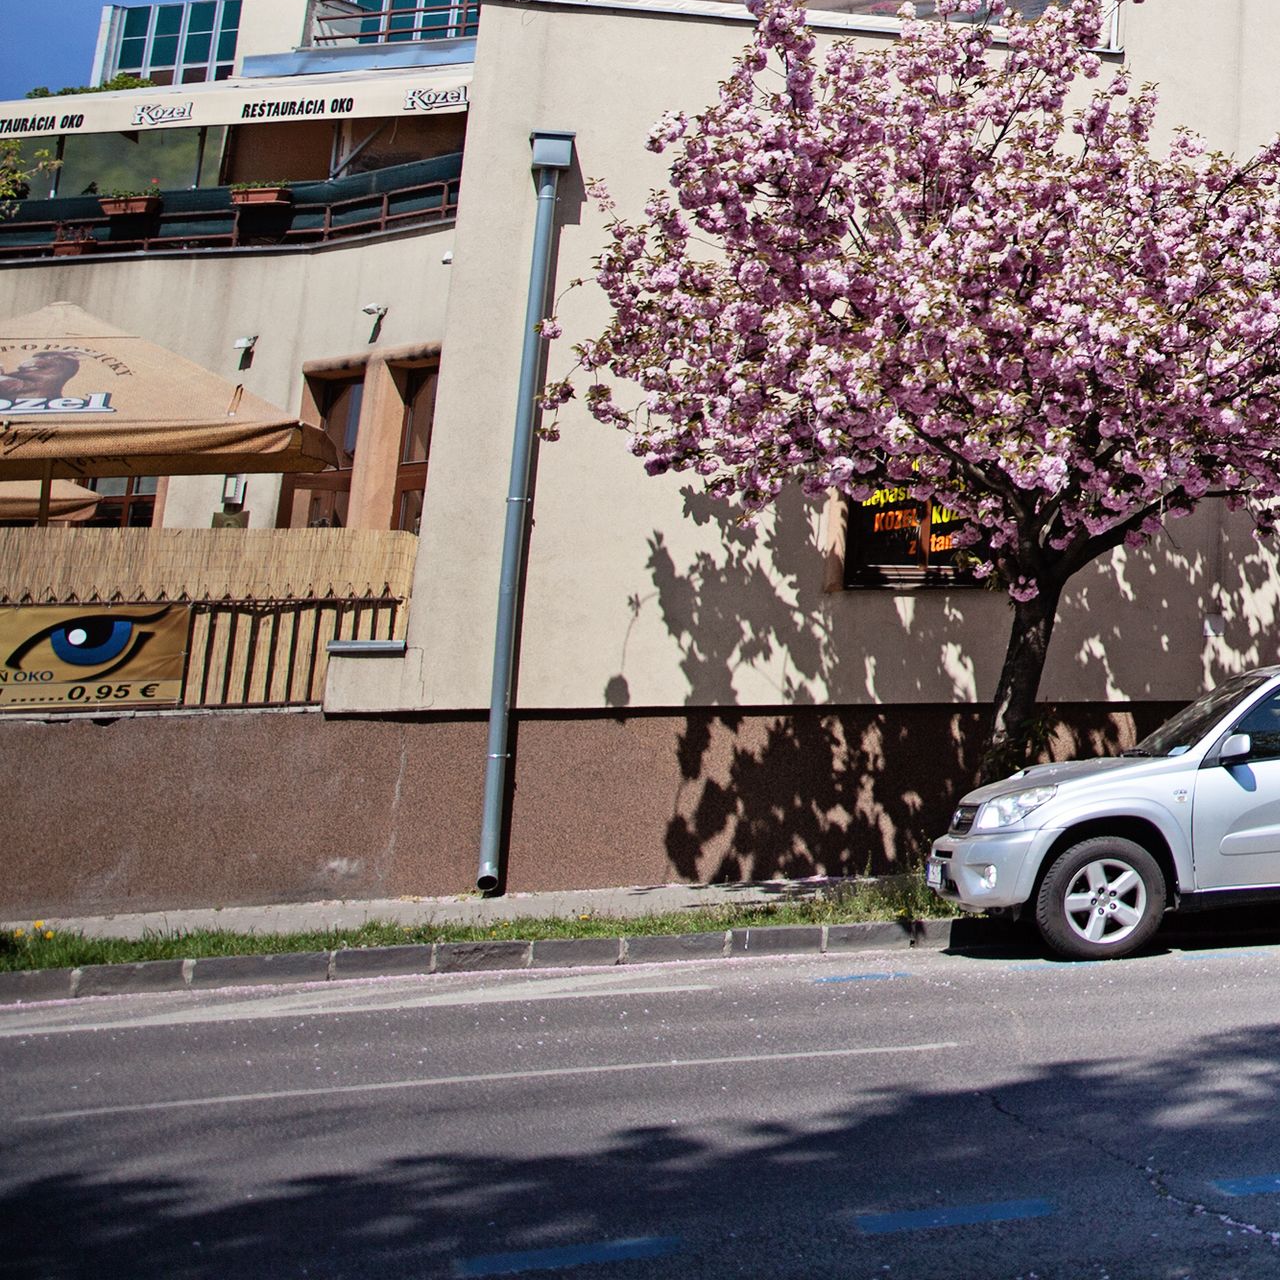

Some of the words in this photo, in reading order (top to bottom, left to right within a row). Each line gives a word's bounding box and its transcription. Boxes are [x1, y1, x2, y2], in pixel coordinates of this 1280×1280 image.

[330, 97, 354, 113] OKO
[402, 85, 470, 111] Kozel
[60, 113, 85, 129] OKO
[131, 102, 194, 126] Kozel
[873, 508, 921, 532] KOZEL
[13, 670, 54, 683] OKO
[139, 683, 160, 698] €
